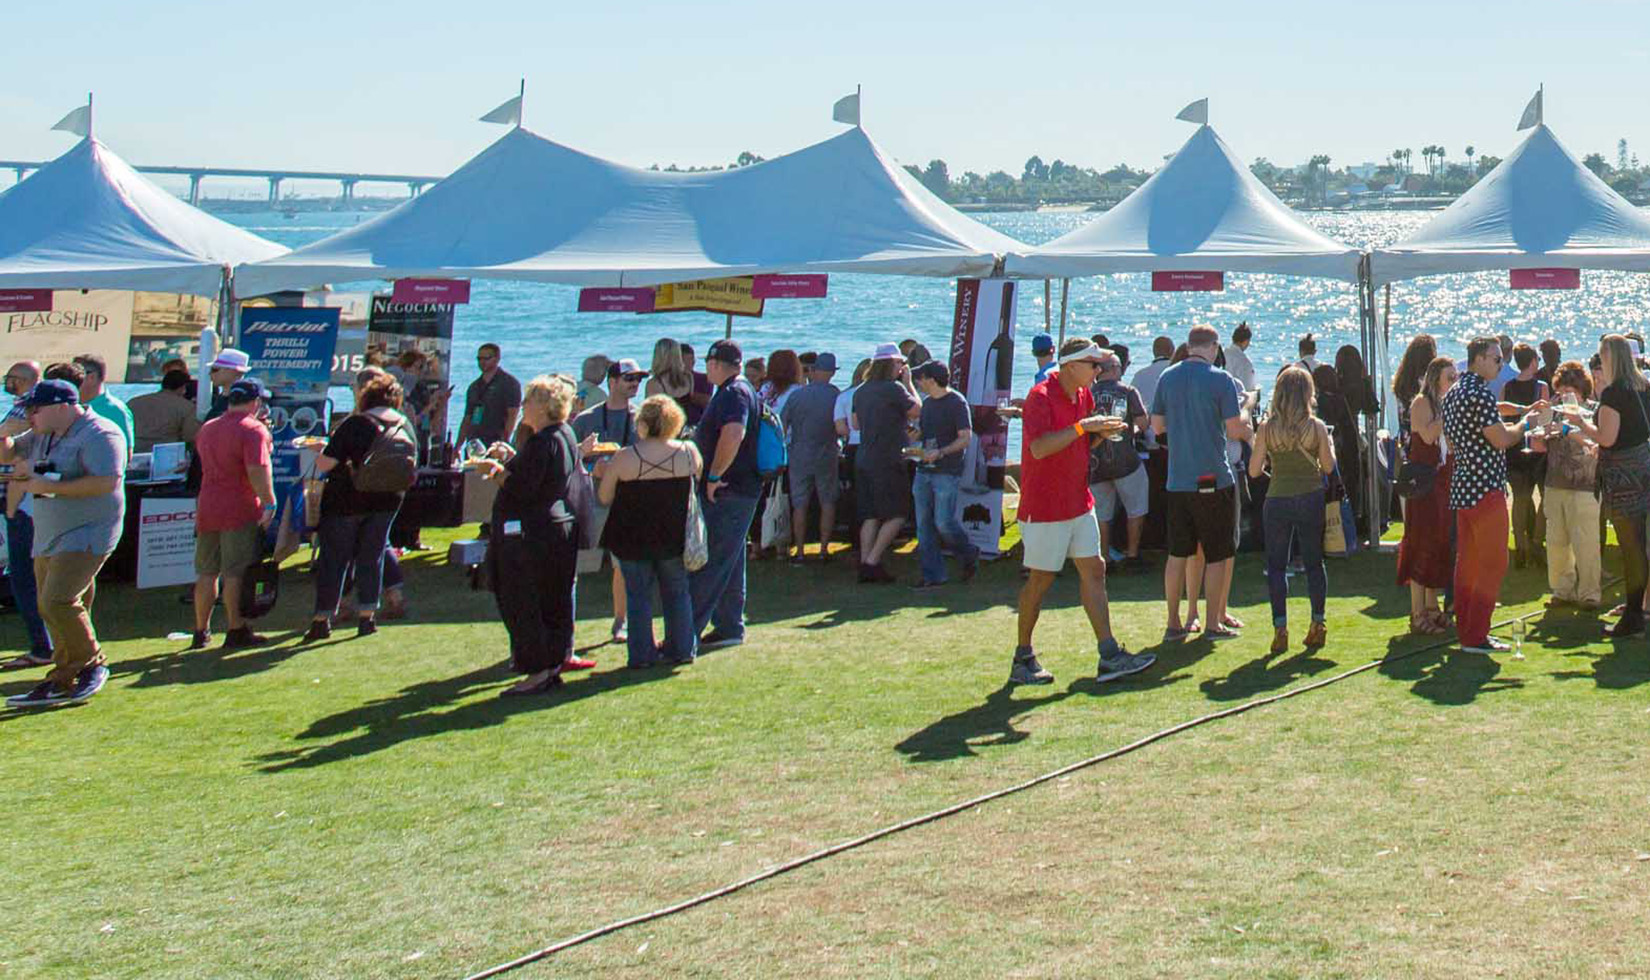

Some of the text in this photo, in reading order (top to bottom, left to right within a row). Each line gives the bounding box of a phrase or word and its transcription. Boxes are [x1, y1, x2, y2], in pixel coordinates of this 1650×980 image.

[729, 282, 753, 294] Wine
[7, 311, 108, 334] FLAGSHIP
[243, 321, 331, 334] Patriot
[952, 286, 973, 358] WINERY
[262, 349, 308, 359] POWER!
[251, 360, 322, 369] XCITEMENT!
